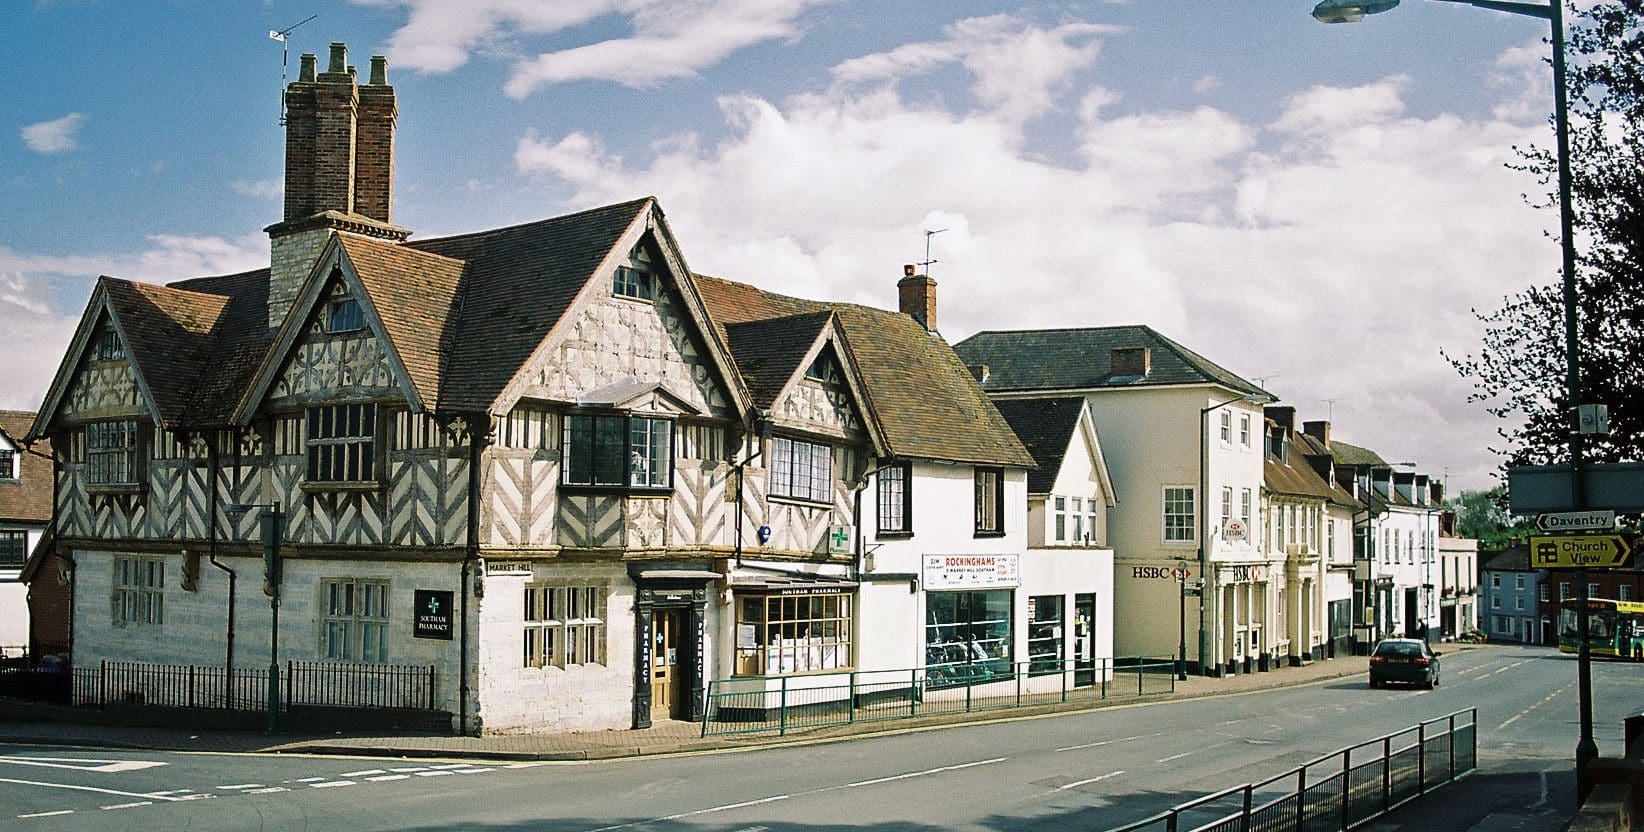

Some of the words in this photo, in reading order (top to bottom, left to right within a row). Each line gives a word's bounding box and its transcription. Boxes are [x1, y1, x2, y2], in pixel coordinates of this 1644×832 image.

[1550, 515, 1607, 527] Daventry
[1226, 529, 1244, 537] HSBC
[1562, 541, 1608, 551] Church
[946, 557, 995, 567] ROCKINGHAMS
[1570, 553, 1601, 563] View
[1132, 566, 1169, 578] HSBC
[1233, 565, 1250, 581] HSBC
[420, 615, 447, 623] SOUTHAM
[418, 623, 448, 631] PHARMACY
